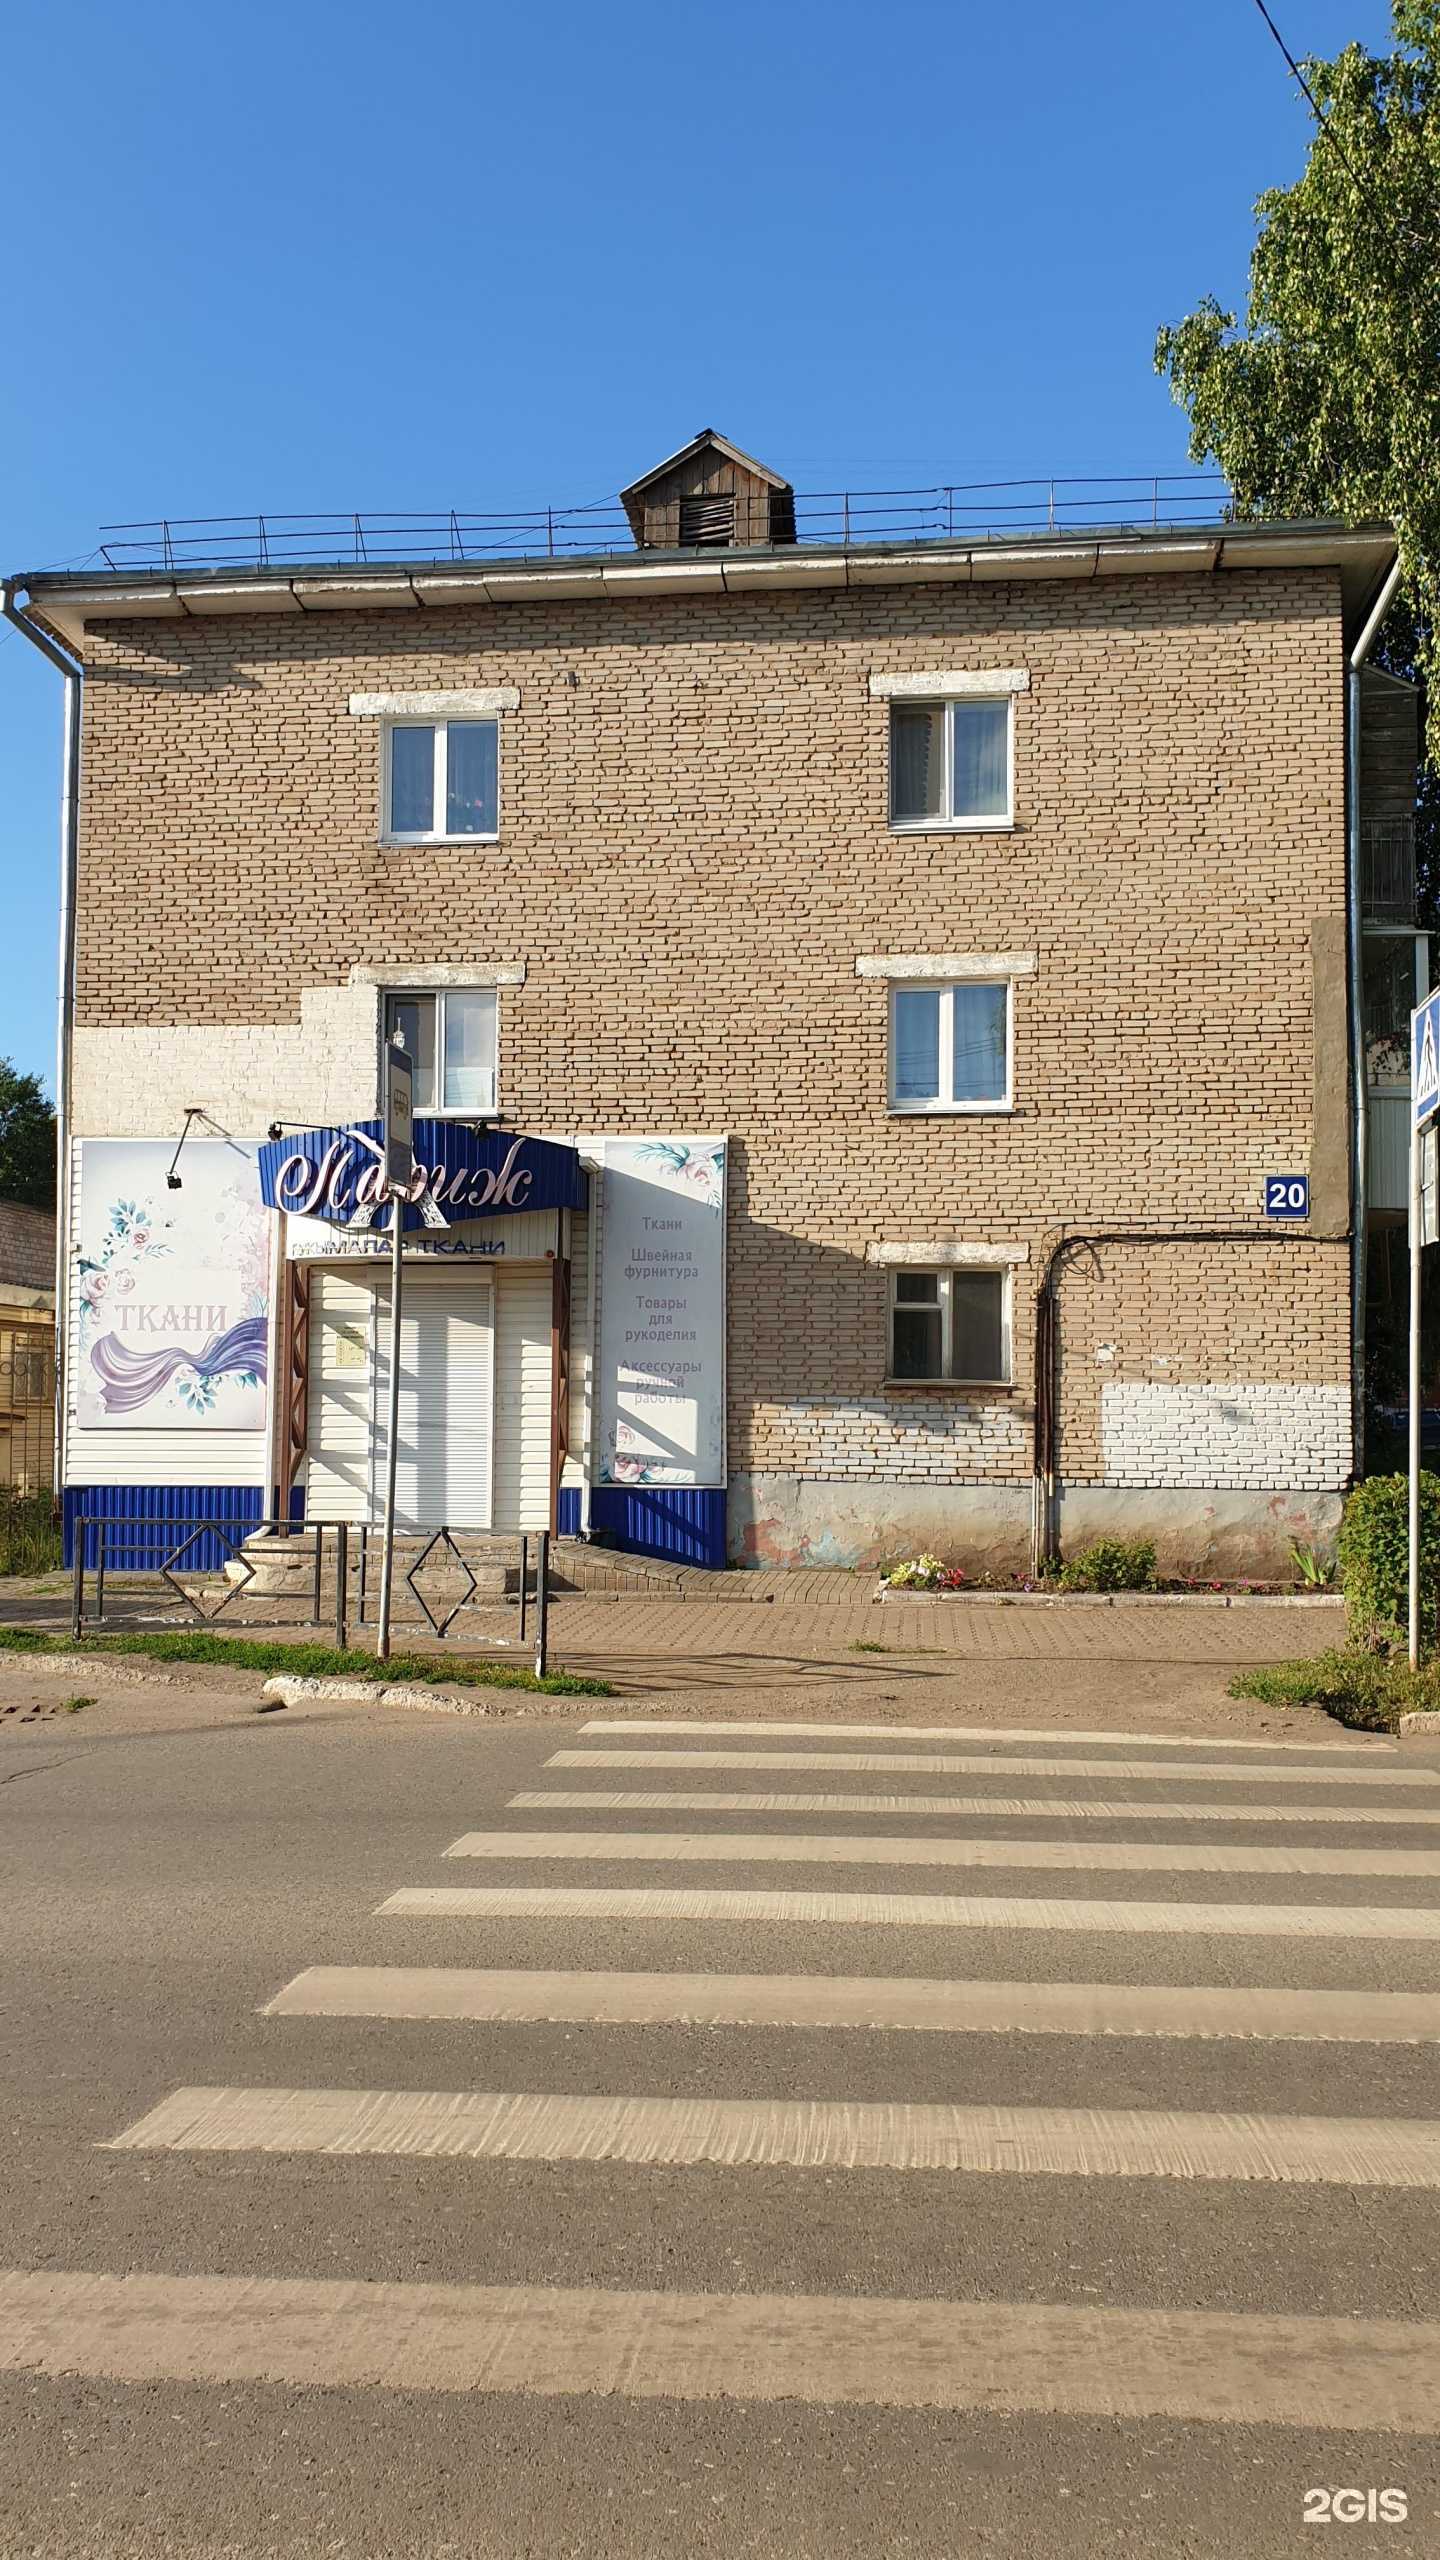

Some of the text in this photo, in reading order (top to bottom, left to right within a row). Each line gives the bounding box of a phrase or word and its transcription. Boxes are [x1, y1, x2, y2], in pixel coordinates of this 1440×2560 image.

[1269, 1183, 1305, 1208] 20
[642, 1216, 682, 1231] Ткани
[418, 1239, 505, 1255] ТКАНИ
[631, 1248, 693, 1261] Швейная
[624, 1264, 699, 1280] фурнитура
[635, 1295, 687, 1311] Товары
[114, 1304, 228, 1332] ТКАНИ
[648, 1315, 673, 1326] для
[625, 1330, 697, 1343] рукоделия
[620, 1360, 702, 1375] Аксессуары
[636, 1376, 685, 1390] ручной
[634, 1391, 686, 1405] работы
